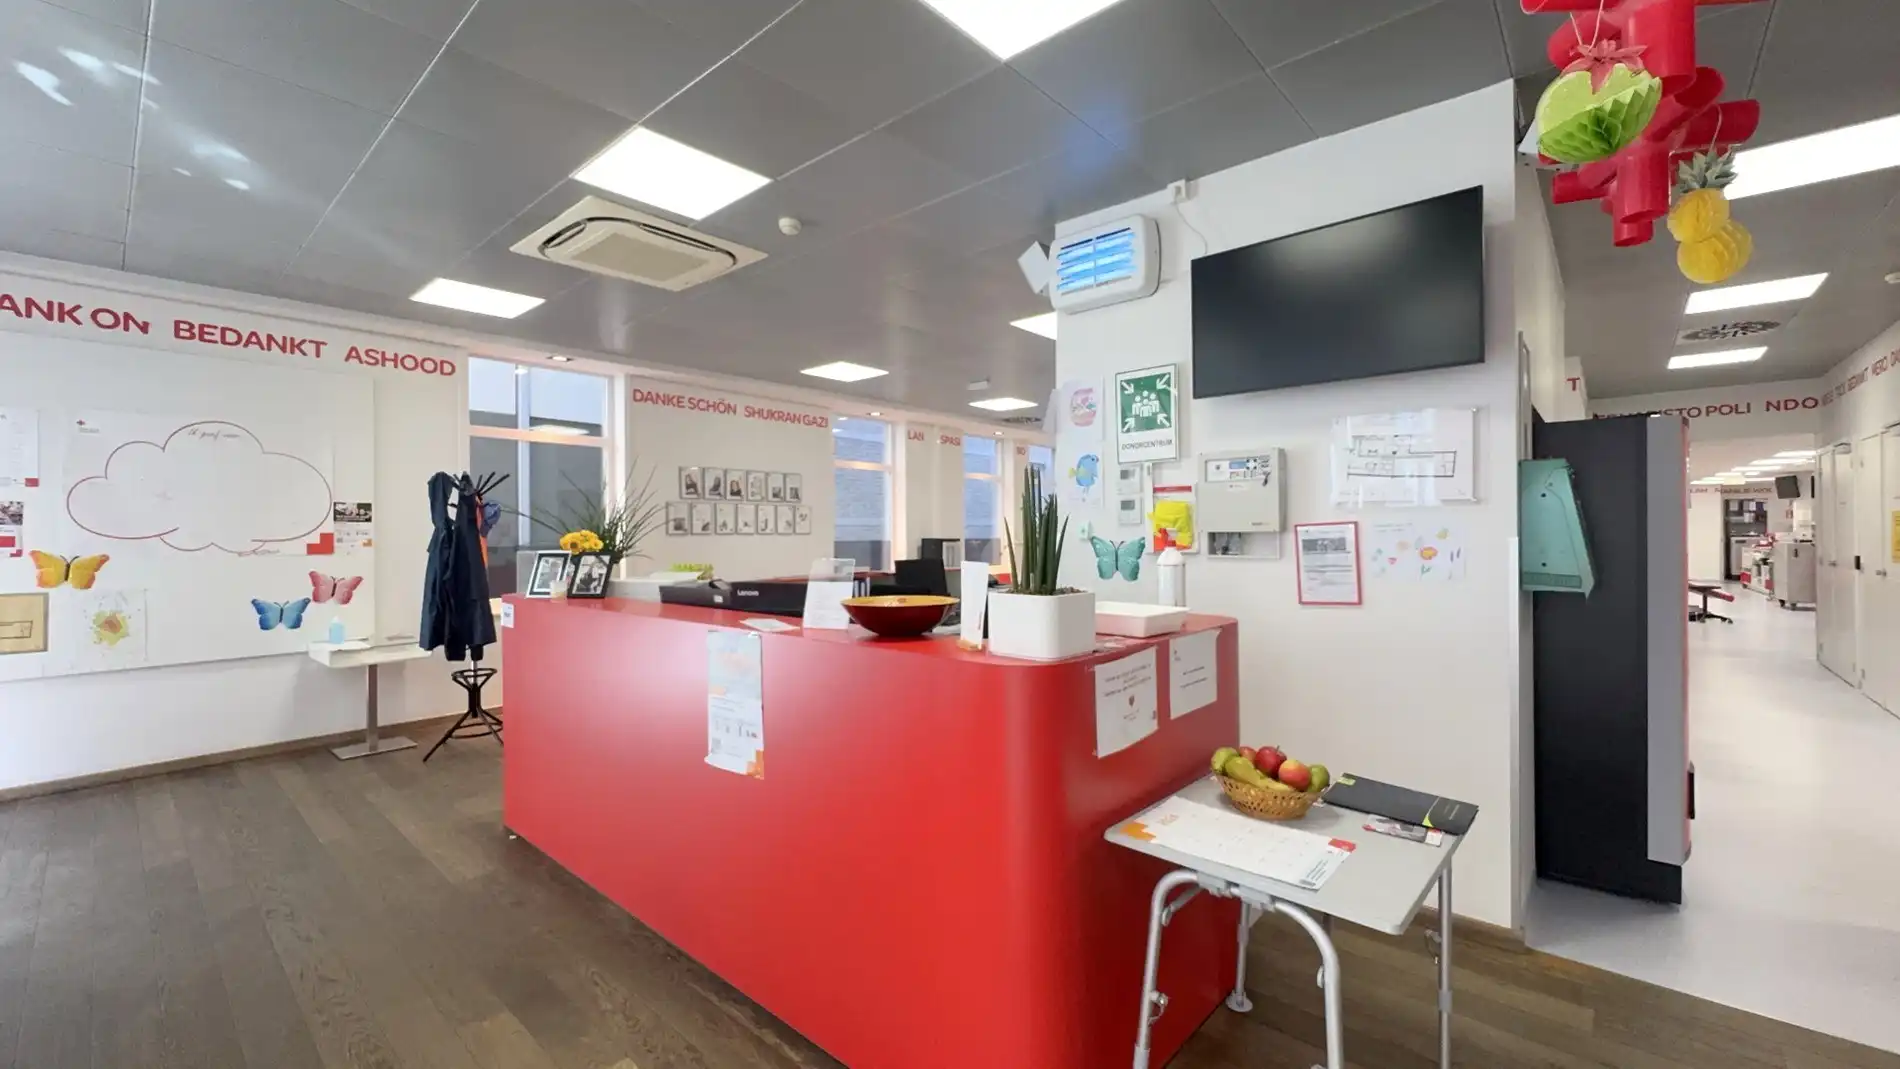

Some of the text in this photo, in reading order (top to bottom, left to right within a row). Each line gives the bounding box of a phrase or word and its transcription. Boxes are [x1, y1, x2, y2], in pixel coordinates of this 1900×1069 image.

[173, 319, 328, 359] BEDANKT
[345, 346, 457, 377] ASHOOD
[632, 388, 686, 409] DANKE
[687, 396, 737, 416] SCHÖN
[744, 405, 801, 424] SHUKRAN
[1705, 402, 1751, 417] POLI
[1766, 396, 1819, 412] NDO
[1121, 439, 1173, 450] DONORCENTRUM
